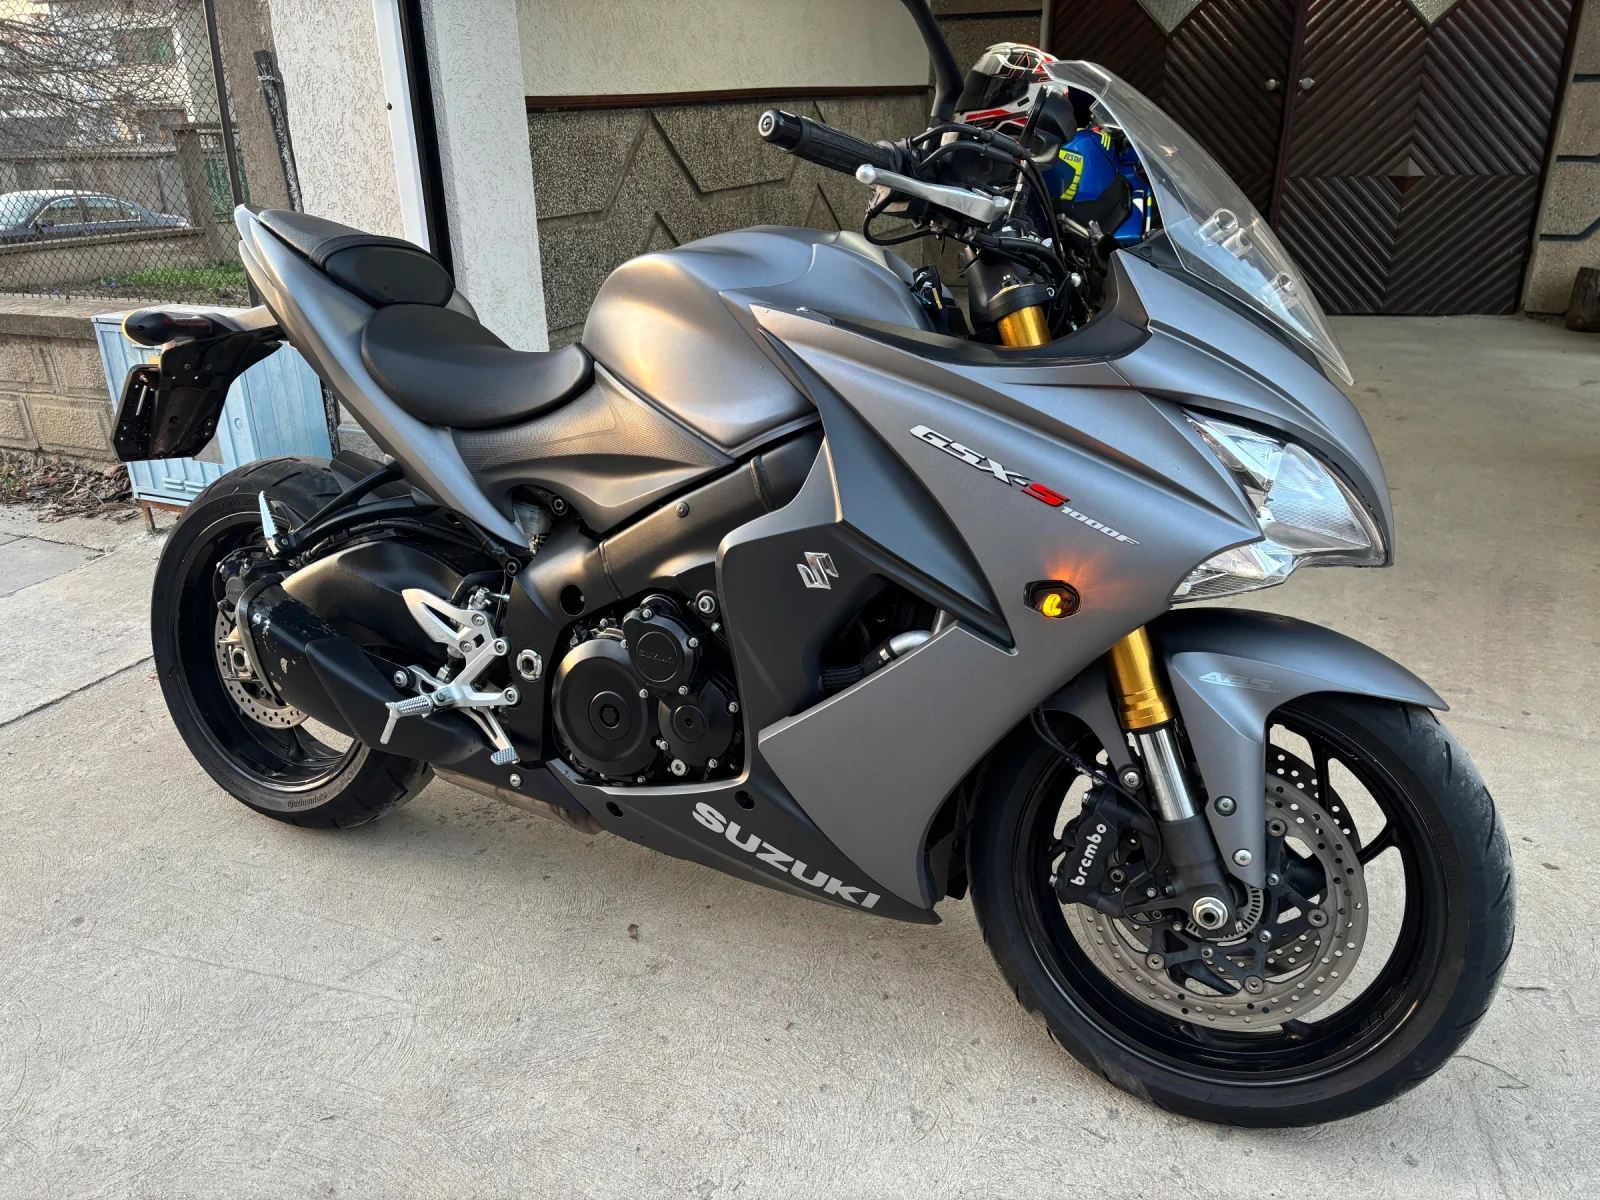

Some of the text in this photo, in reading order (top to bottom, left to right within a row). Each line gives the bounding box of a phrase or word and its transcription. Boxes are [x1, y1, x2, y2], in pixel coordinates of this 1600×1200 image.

[1199, 671, 1275, 690] ABS
[692, 801, 881, 909] SUZUKI
[1070, 823, 1107, 886] brembo
